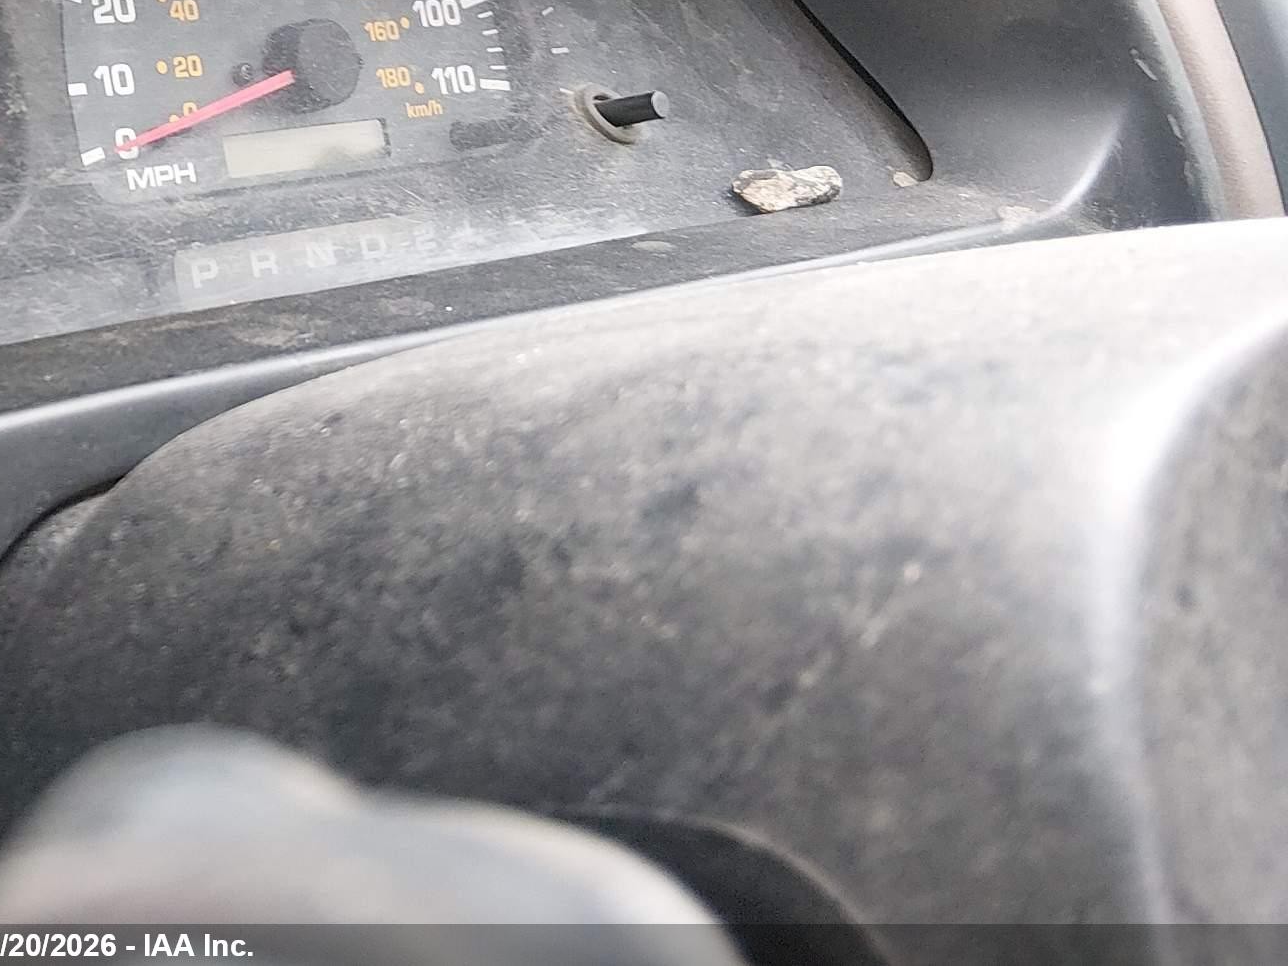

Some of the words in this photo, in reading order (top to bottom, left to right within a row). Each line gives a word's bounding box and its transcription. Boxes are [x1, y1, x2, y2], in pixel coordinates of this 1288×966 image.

[169, 0, 200, 21] 40
[413, 0, 461, 27] 100
[364, 20, 400, 42] 160
[94, 63, 135, 95] 10
[172, 55, 203, 78] 20
[376, 66, 411, 89] 180
[431, 65, 476, 95] 110
[406, 99, 443, 119] km/h
[115, 128, 139, 160] 0
[126, 162, 197, 191] MPH
[191, 257, 218, 289] P
[250, 245, 279, 277] R
